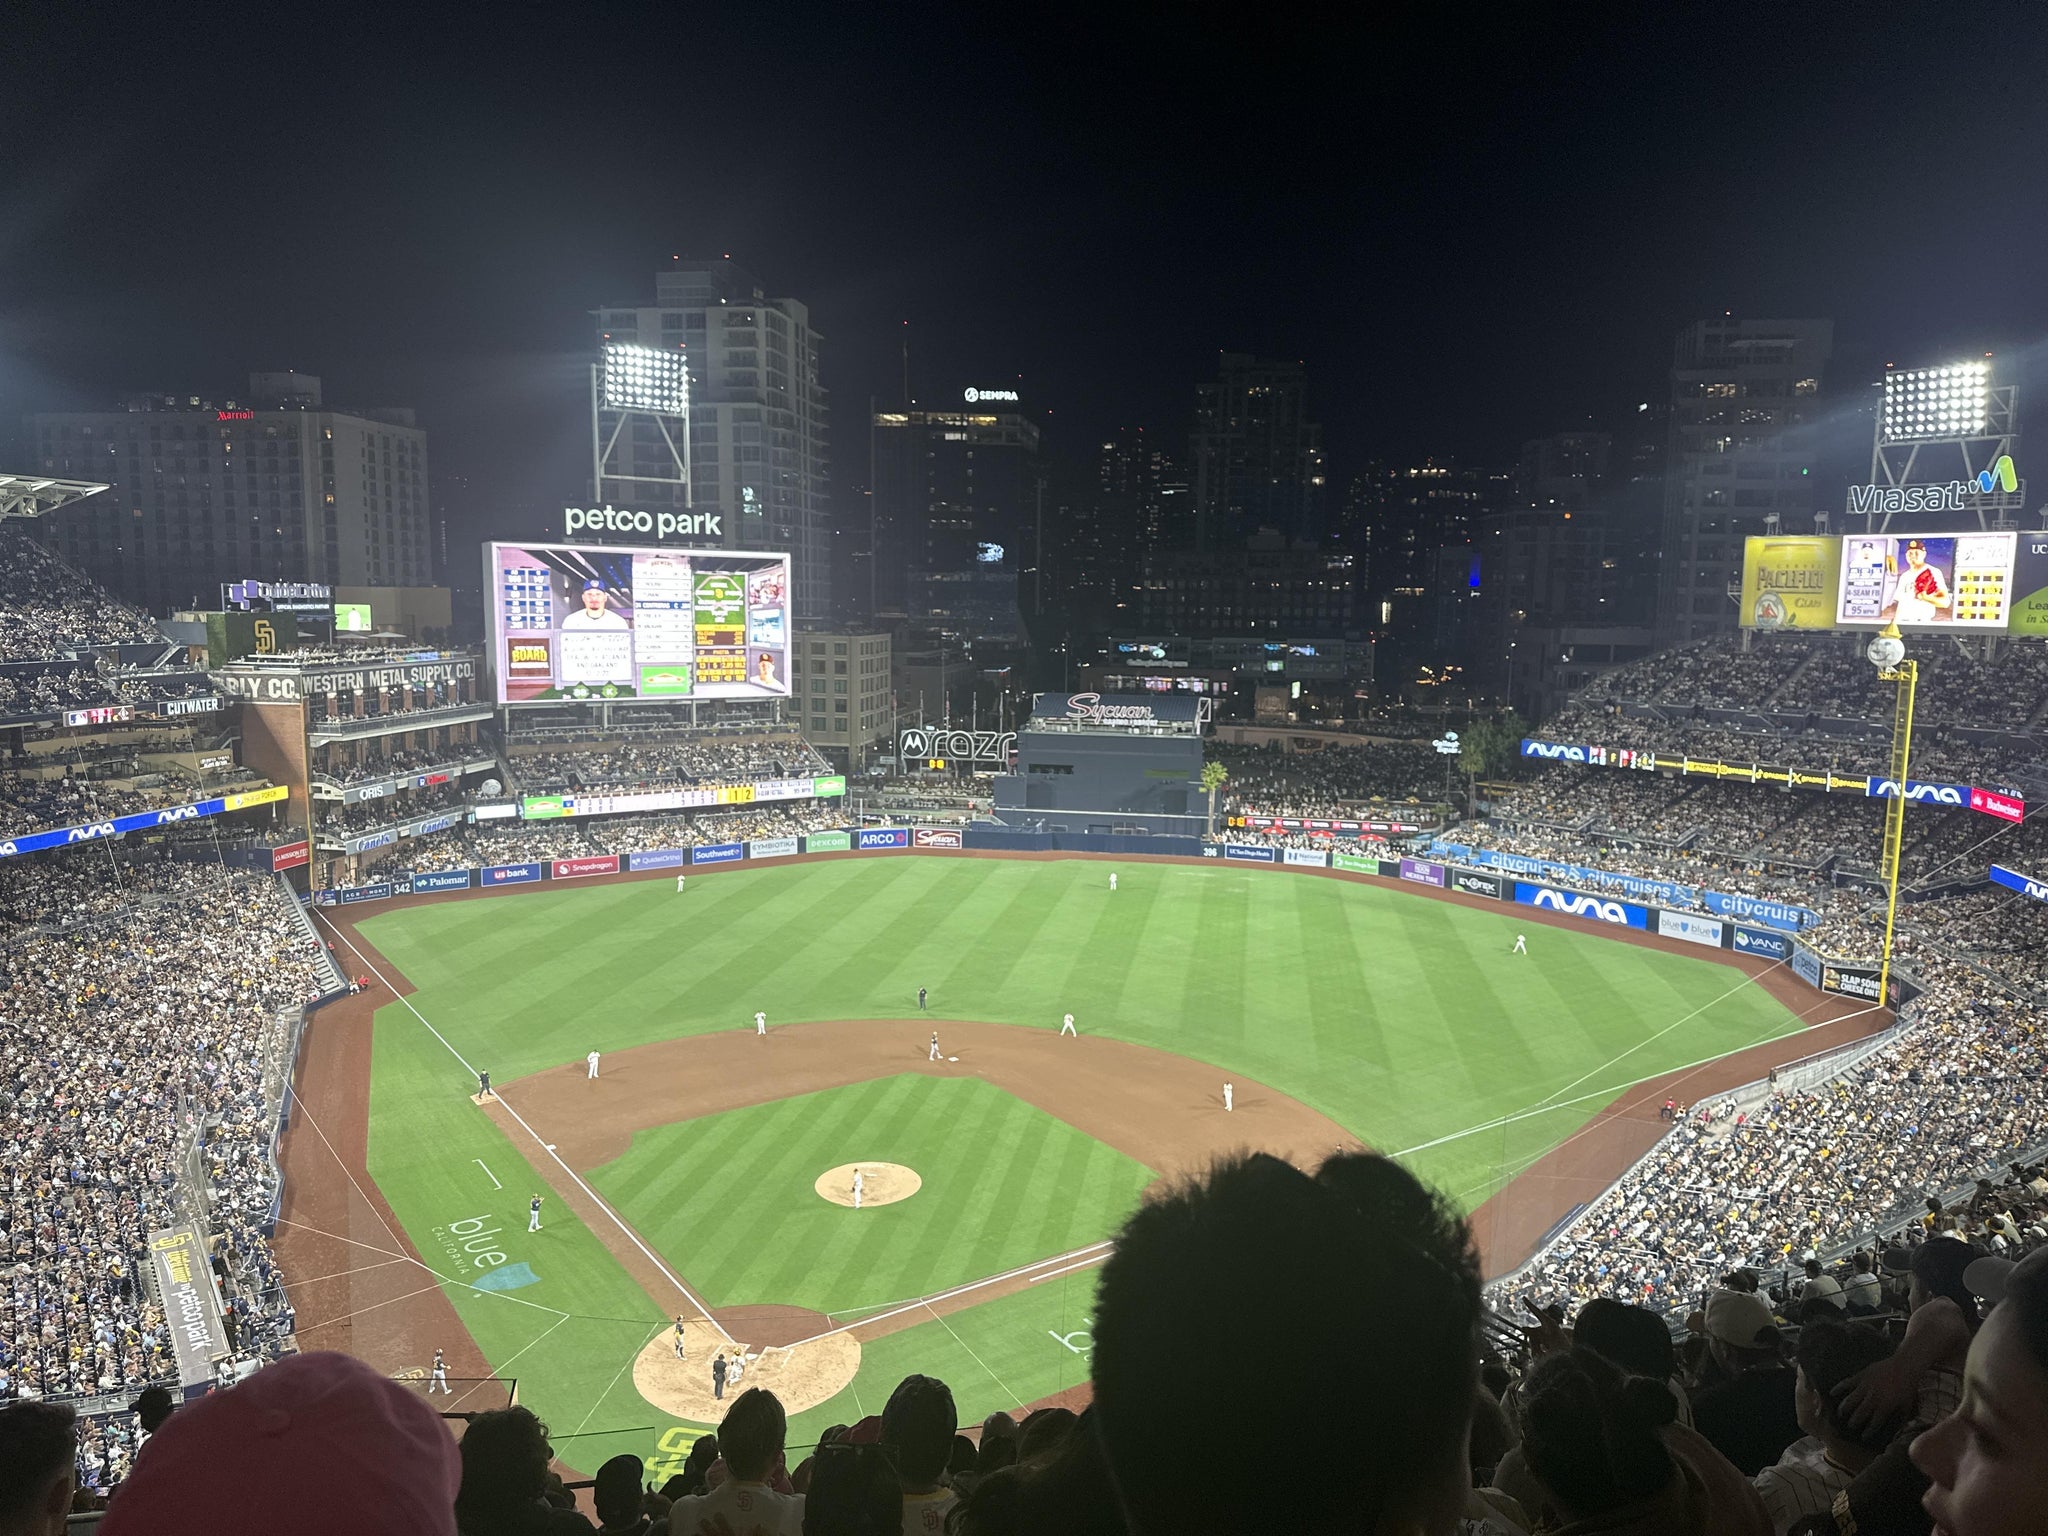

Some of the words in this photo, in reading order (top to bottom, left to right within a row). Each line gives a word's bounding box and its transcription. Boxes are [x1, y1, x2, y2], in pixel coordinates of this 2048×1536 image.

[979, 391, 1018, 401] SEMPRA
[217, 411, 254, 421] Marriott
[1850, 481, 1964, 514] Viasat
[565, 504, 653, 536] petco
[657, 512, 722, 540] park
[1851, 605, 1862, 614] 95
[512, 649, 547, 662] BOARD
[303, 671, 364, 694] WESTERN
[369, 666, 409, 688] METAL
[411, 664, 452, 683] SUPPLY
[456, 663, 474, 679] CO.
[267, 678, 301, 700] CO.
[167, 699, 219, 715] CUTWATER
[1066, 692, 1154, 724] Sycuan
[930, 730, 1017, 761] razr
[1527, 742, 1586, 760] nuna
[359, 785, 384, 800] ORIS
[745, 789, 751, 800] 2
[1877, 780, 1962, 804] nuna
[158, 806, 199, 823] nuna
[1986, 797, 2021, 818] Budweiser
[68, 822, 116, 842] nuna
[861, 833, 894, 845] ARCO
[917, 830, 957, 846] Sycuan
[695, 849, 734, 860] Southwest
[1203, 847, 1217, 857] 396
[494, 870, 505, 878] us
[506, 868, 529, 878] bank
[572, 862, 613, 873] Snapdragon
[429, 877, 467, 887] Palomar
[1425, 874, 1440, 885] TIRE
[394, 883, 410, 894] 342
[1534, 888, 1628, 925] nuna
[1661, 918, 1680, 930] blue
[1691, 924, 1711, 935] blue
[1841, 973, 1861, 985] SLAP
[1840, 984, 1865, 995] CHEESE
[1864, 988, 1873, 996] ON
[448, 1214, 507, 1268] blue
[431, 1226, 471, 1275] CALIFORNIA
[171, 1286, 206, 1322] petco
[179, 1320, 214, 1352] park
